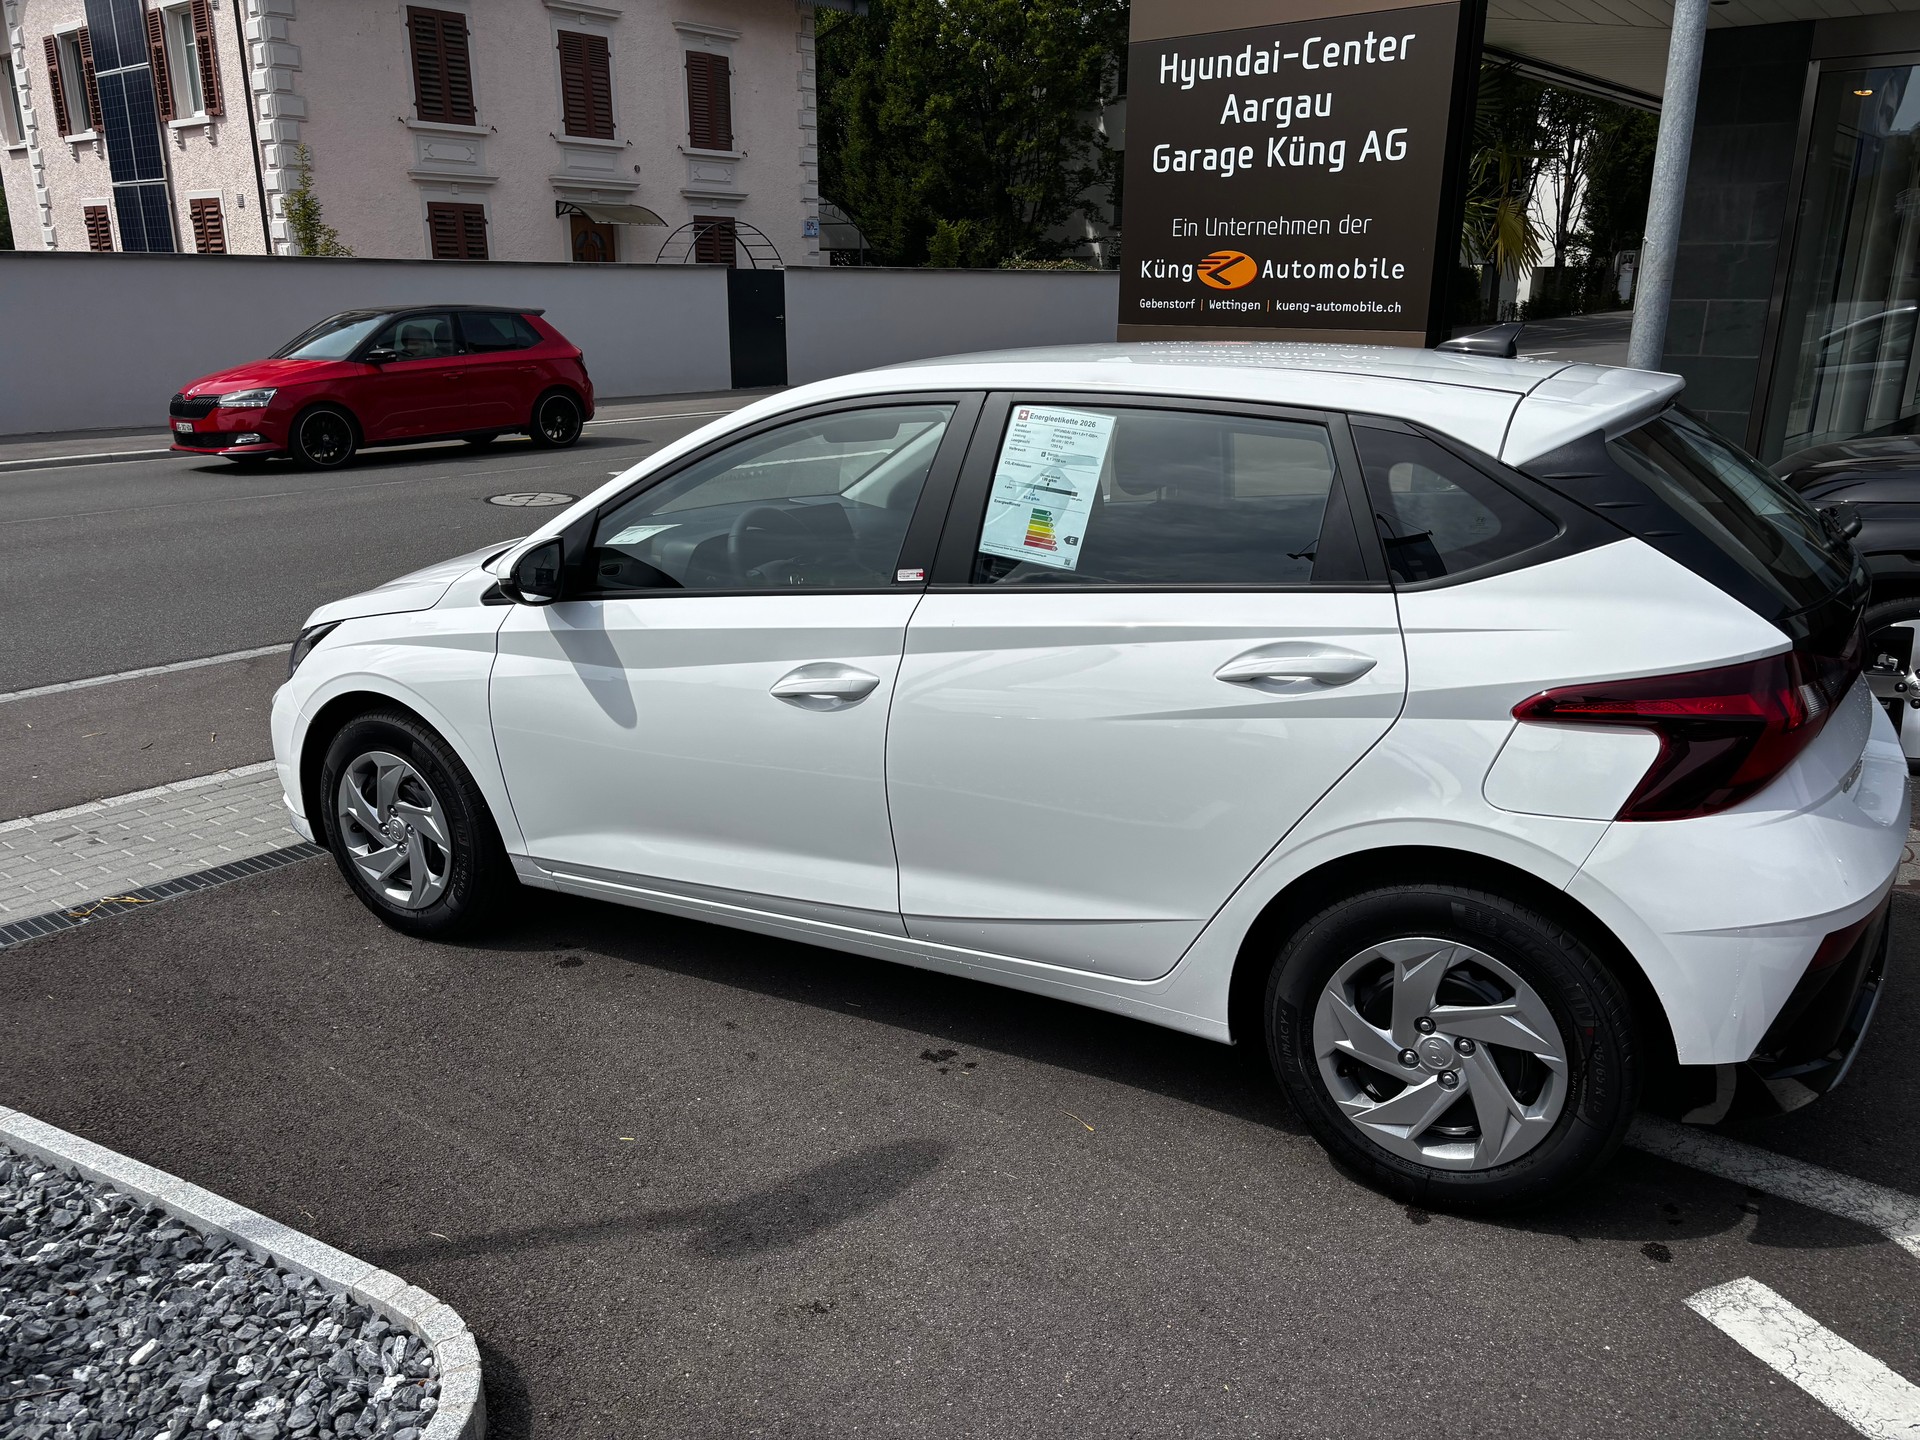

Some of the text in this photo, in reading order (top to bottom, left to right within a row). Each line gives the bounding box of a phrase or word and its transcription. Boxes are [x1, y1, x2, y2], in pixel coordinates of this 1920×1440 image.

[1159, 30, 1416, 90] Hyundai-Center
[1219, 92, 1332, 129] Aargau
[1152, 127, 1408, 178] Garage Küng AG
[1172, 213, 1373, 237] Ein Unternehmen der
[1140, 257, 1405, 282] Küng Automobile
[1139, 298, 1402, 314] Gebenstorf Wettingen kueng-automobile.ch
[1030, 412, 1097, 428] Energieetikette 2026
